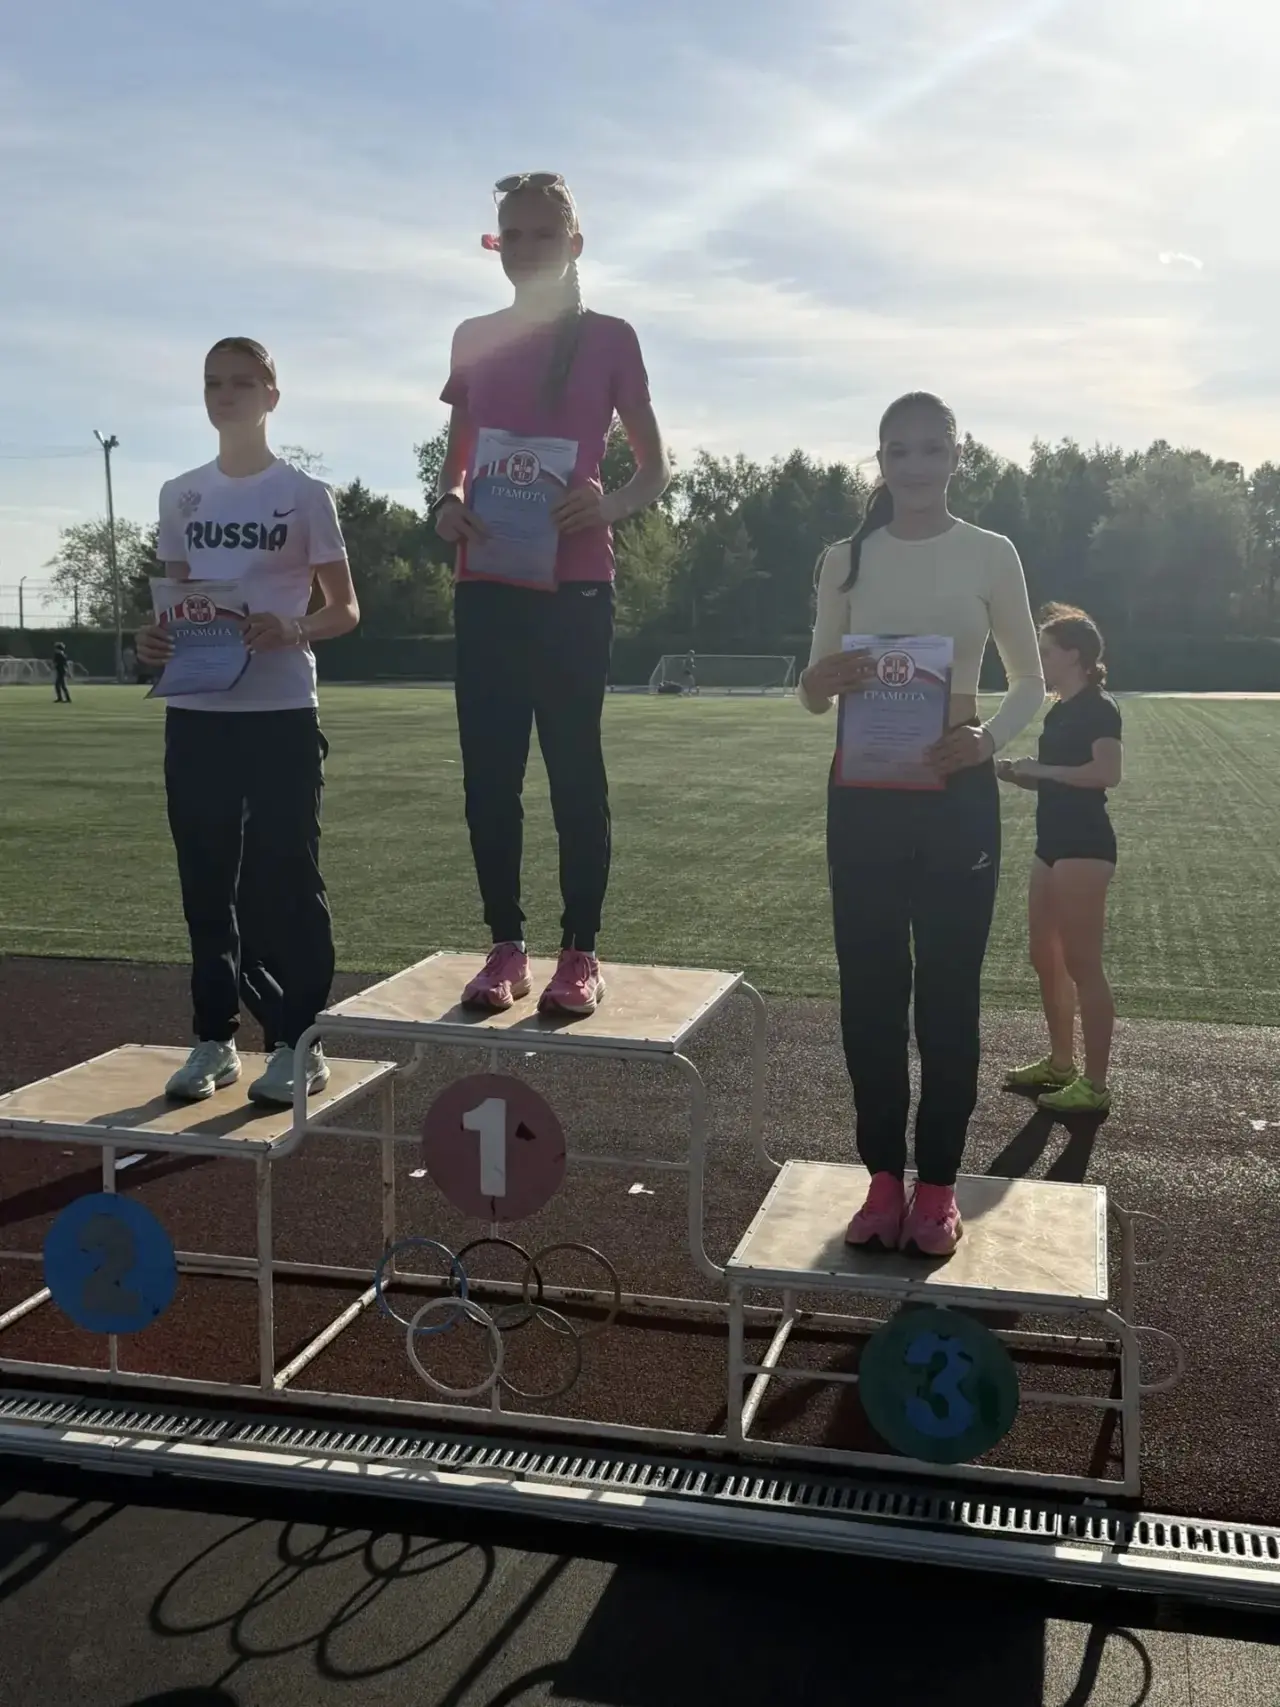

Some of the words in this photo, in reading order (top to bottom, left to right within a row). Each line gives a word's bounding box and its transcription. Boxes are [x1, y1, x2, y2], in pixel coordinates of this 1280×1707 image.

[490, 485, 547, 503] ГРАМОТА
[185, 521, 288, 551] RUSSIA
[175, 627, 232, 638] ГРАМОТА
[863, 690, 926, 701] ГРАМОТА
[462, 1097, 507, 1197] 1
[77, 1211, 142, 1316] 2
[904, 1331, 977, 1439] 3
